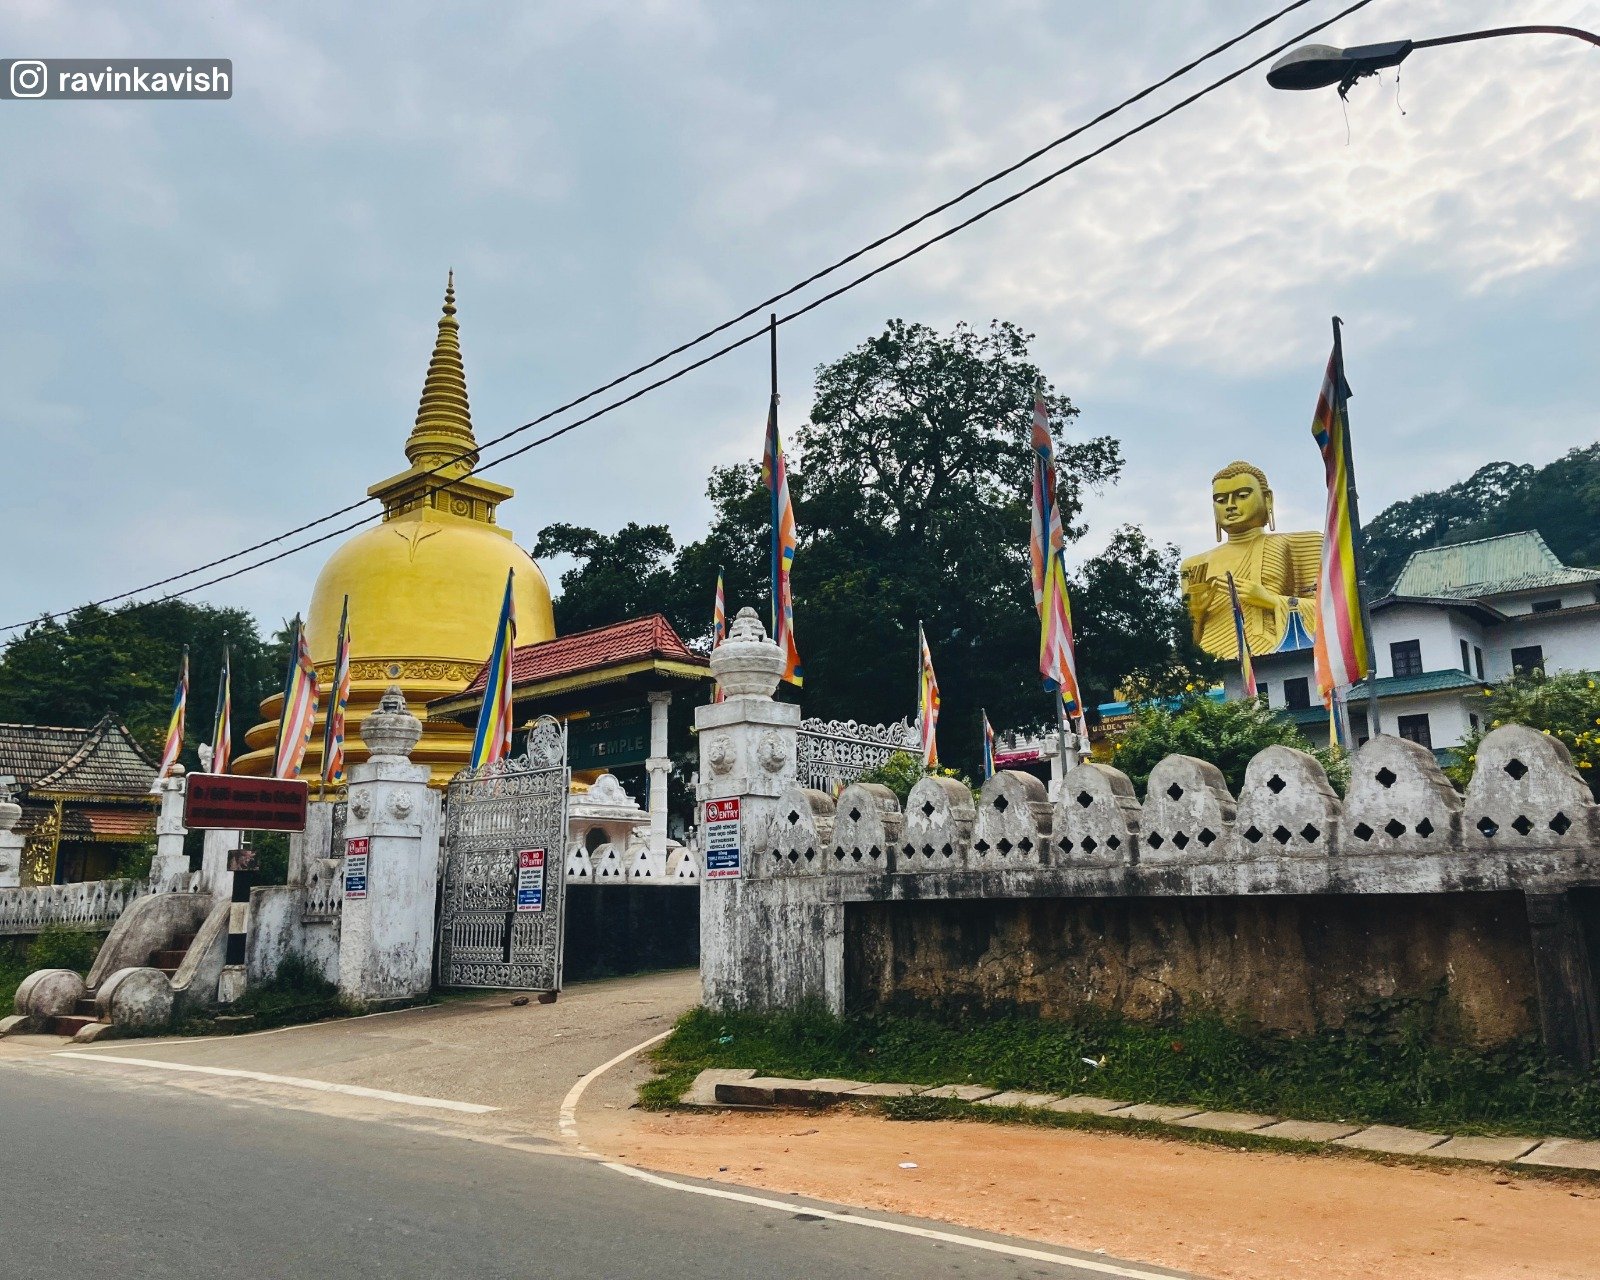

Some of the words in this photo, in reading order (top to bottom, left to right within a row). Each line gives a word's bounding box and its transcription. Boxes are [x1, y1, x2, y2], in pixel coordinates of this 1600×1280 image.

[590, 736, 644, 757] TEMPLE
[724, 802, 733, 811] NO
[719, 810, 739, 820] ENTRY
